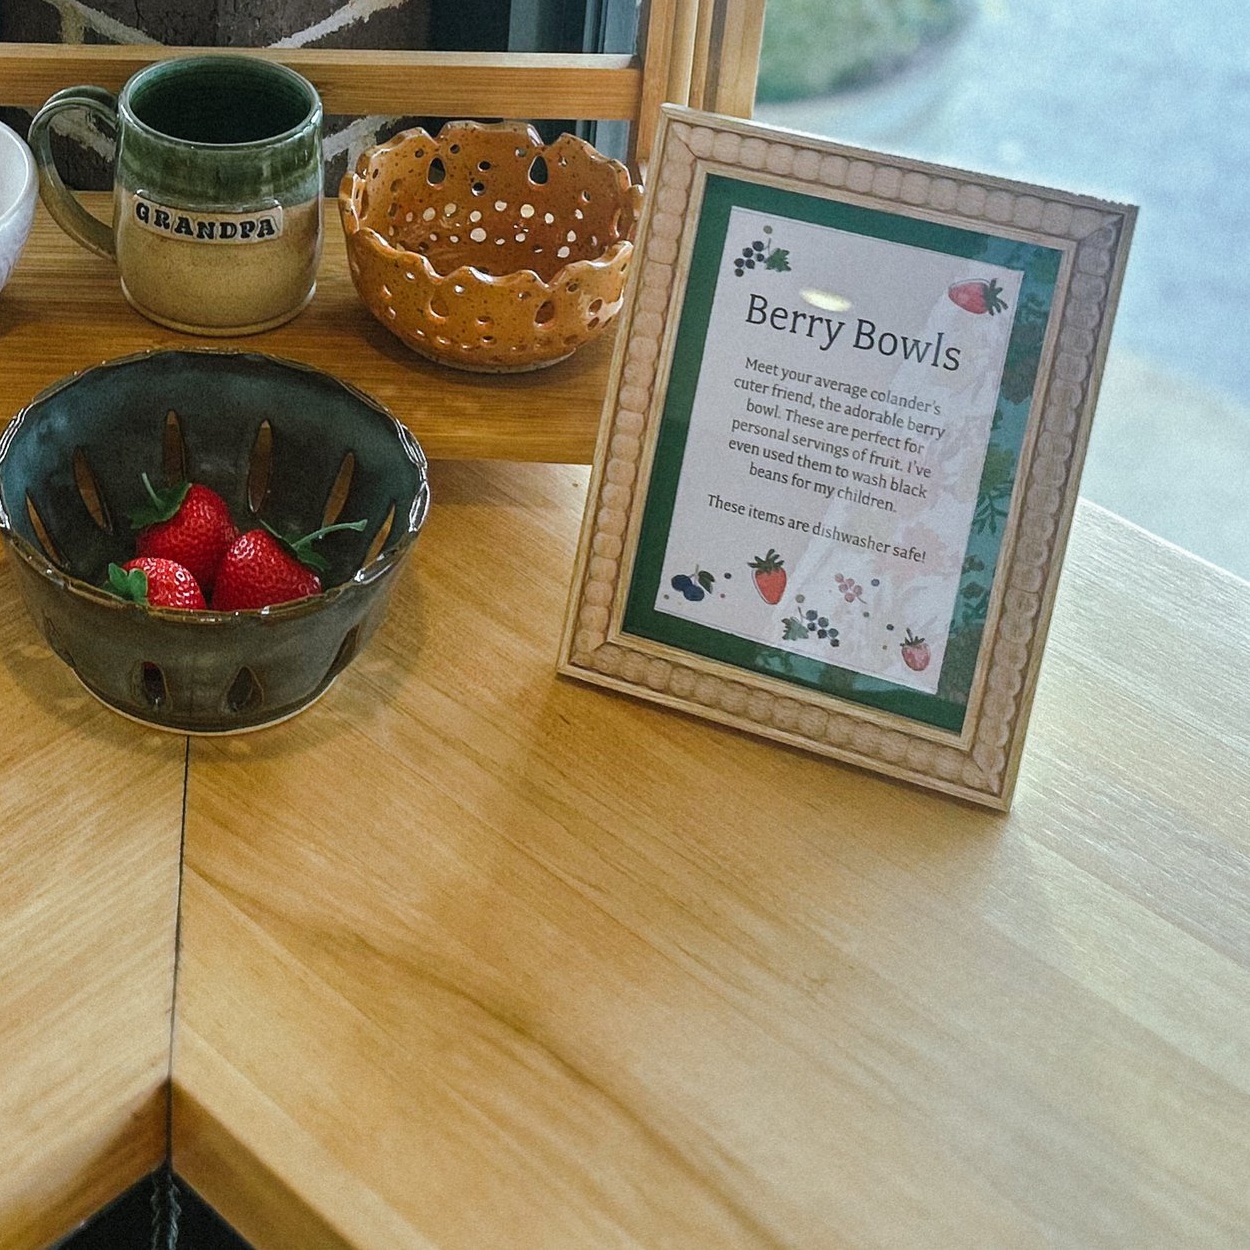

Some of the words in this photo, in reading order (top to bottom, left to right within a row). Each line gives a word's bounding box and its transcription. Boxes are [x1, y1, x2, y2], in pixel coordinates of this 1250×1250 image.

[136, 202, 275, 240] GRANDPA
[745, 293, 845, 351] Berry
[853, 318, 961, 371] Bowls
[734, 378, 769, 394] cuter
[771, 384, 816, 409] friend,
[819, 396, 842, 412] the
[844, 404, 904, 428] adorable
[907, 416, 946, 441] berry
[745, 357, 779, 376] Meet
[780, 368, 813, 384] your
[814, 376, 868, 399] average
[870, 390, 941, 415] colander's
[731, 419, 790, 442] personal
[792, 434, 850, 459] servings
[852, 448, 869, 462] of
[869, 451, 903, 472] fruit.
[906, 460, 932, 478] I've
[746, 398, 782, 419] bowl.
[785, 408, 825, 430] These
[826, 422, 849, 436] are
[850, 427, 902, 449] perfect
[903, 437, 925, 454] for
[728, 439, 759, 456] even
[762, 447, 795, 465] used
[797, 454, 832, 474] them
[835, 465, 849, 478] to
[852, 470, 887, 488] wash
[890, 477, 928, 499] black
[749, 461, 789, 484] beans
[791, 473, 812, 490] for
[813, 481, 835, 499] my
[837, 486, 897, 513] children.
[707, 494, 746, 515] These
[748, 504, 785, 526] items
[787, 518, 810, 533] are
[812, 522, 891, 554] dishwasher
[893, 544, 926, 564] safe!
